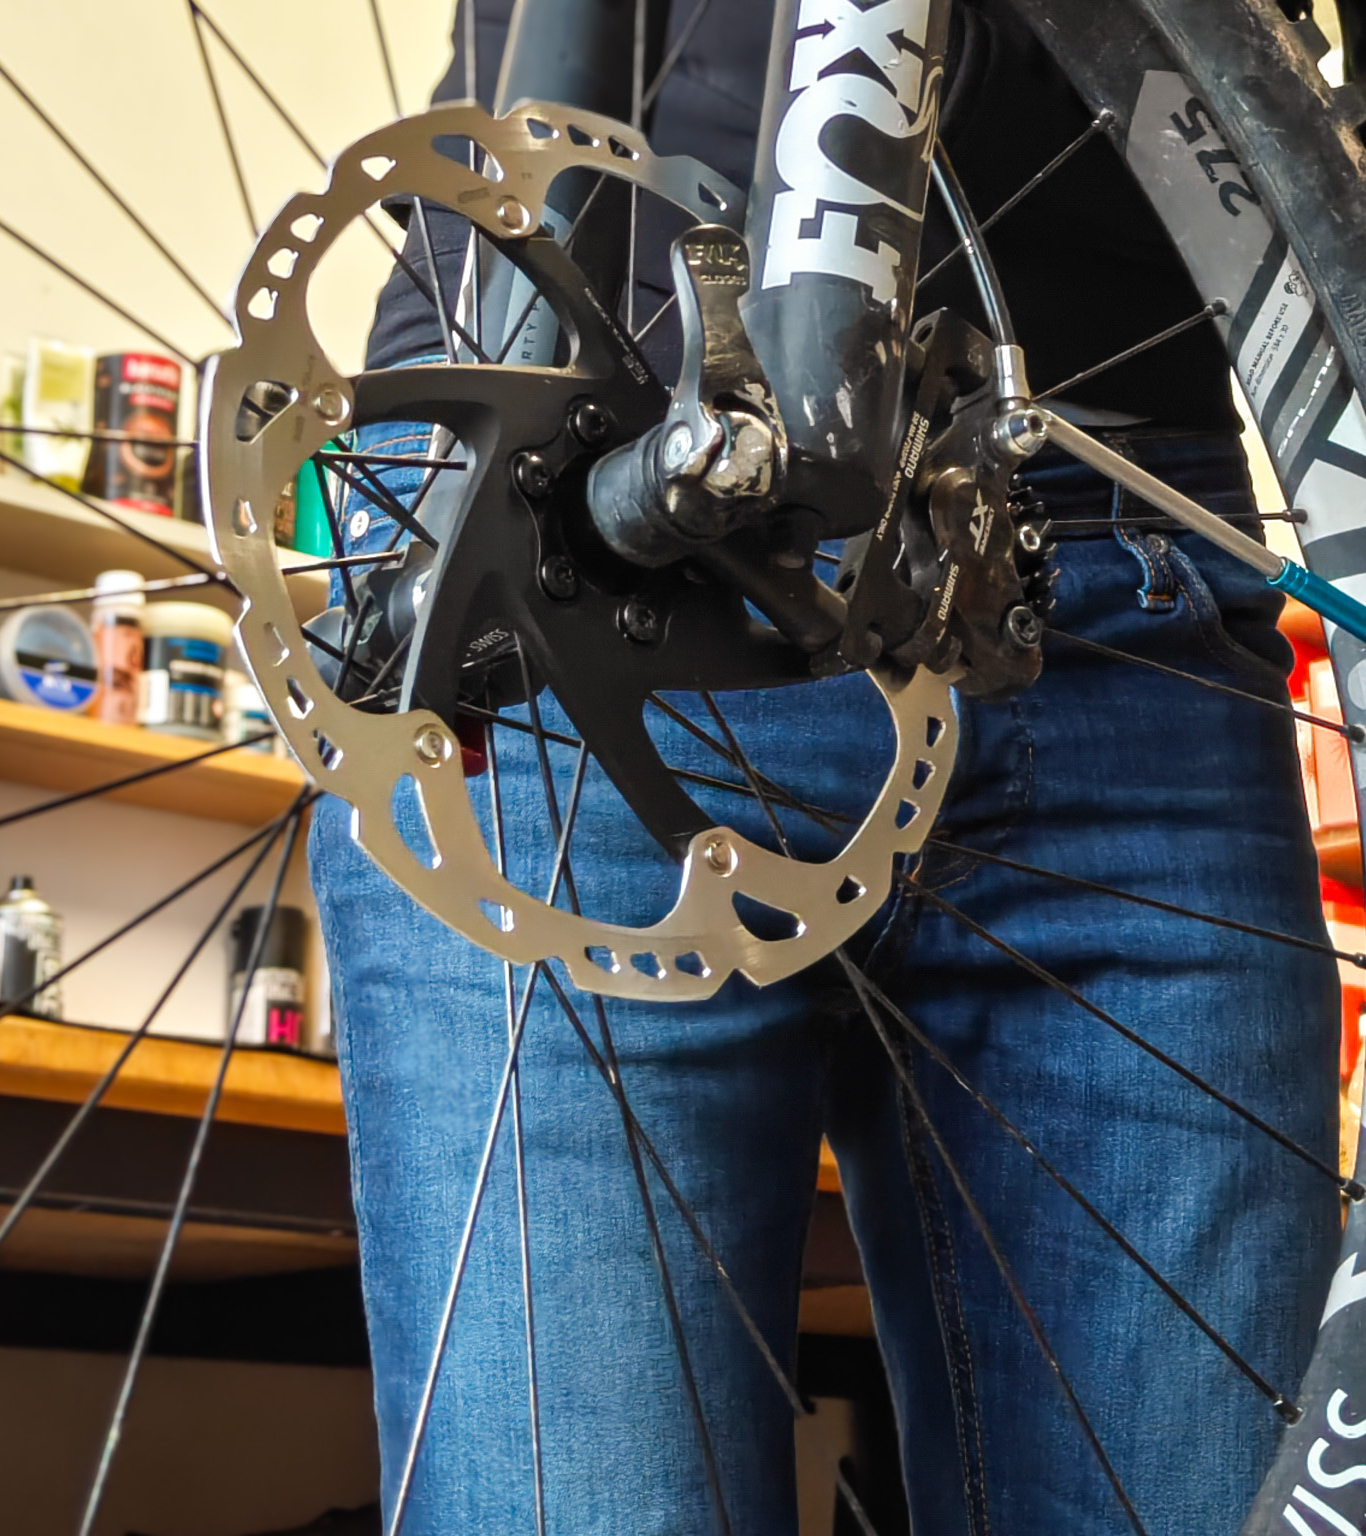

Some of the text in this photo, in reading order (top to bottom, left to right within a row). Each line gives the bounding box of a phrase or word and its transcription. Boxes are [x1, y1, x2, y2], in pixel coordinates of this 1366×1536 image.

[904, 418, 930, 479] SHIMANO
[969, 487, 989, 552] XT
[937, 562, 960, 621] SHIMANO
[469, 628, 509, 652] SWISS
